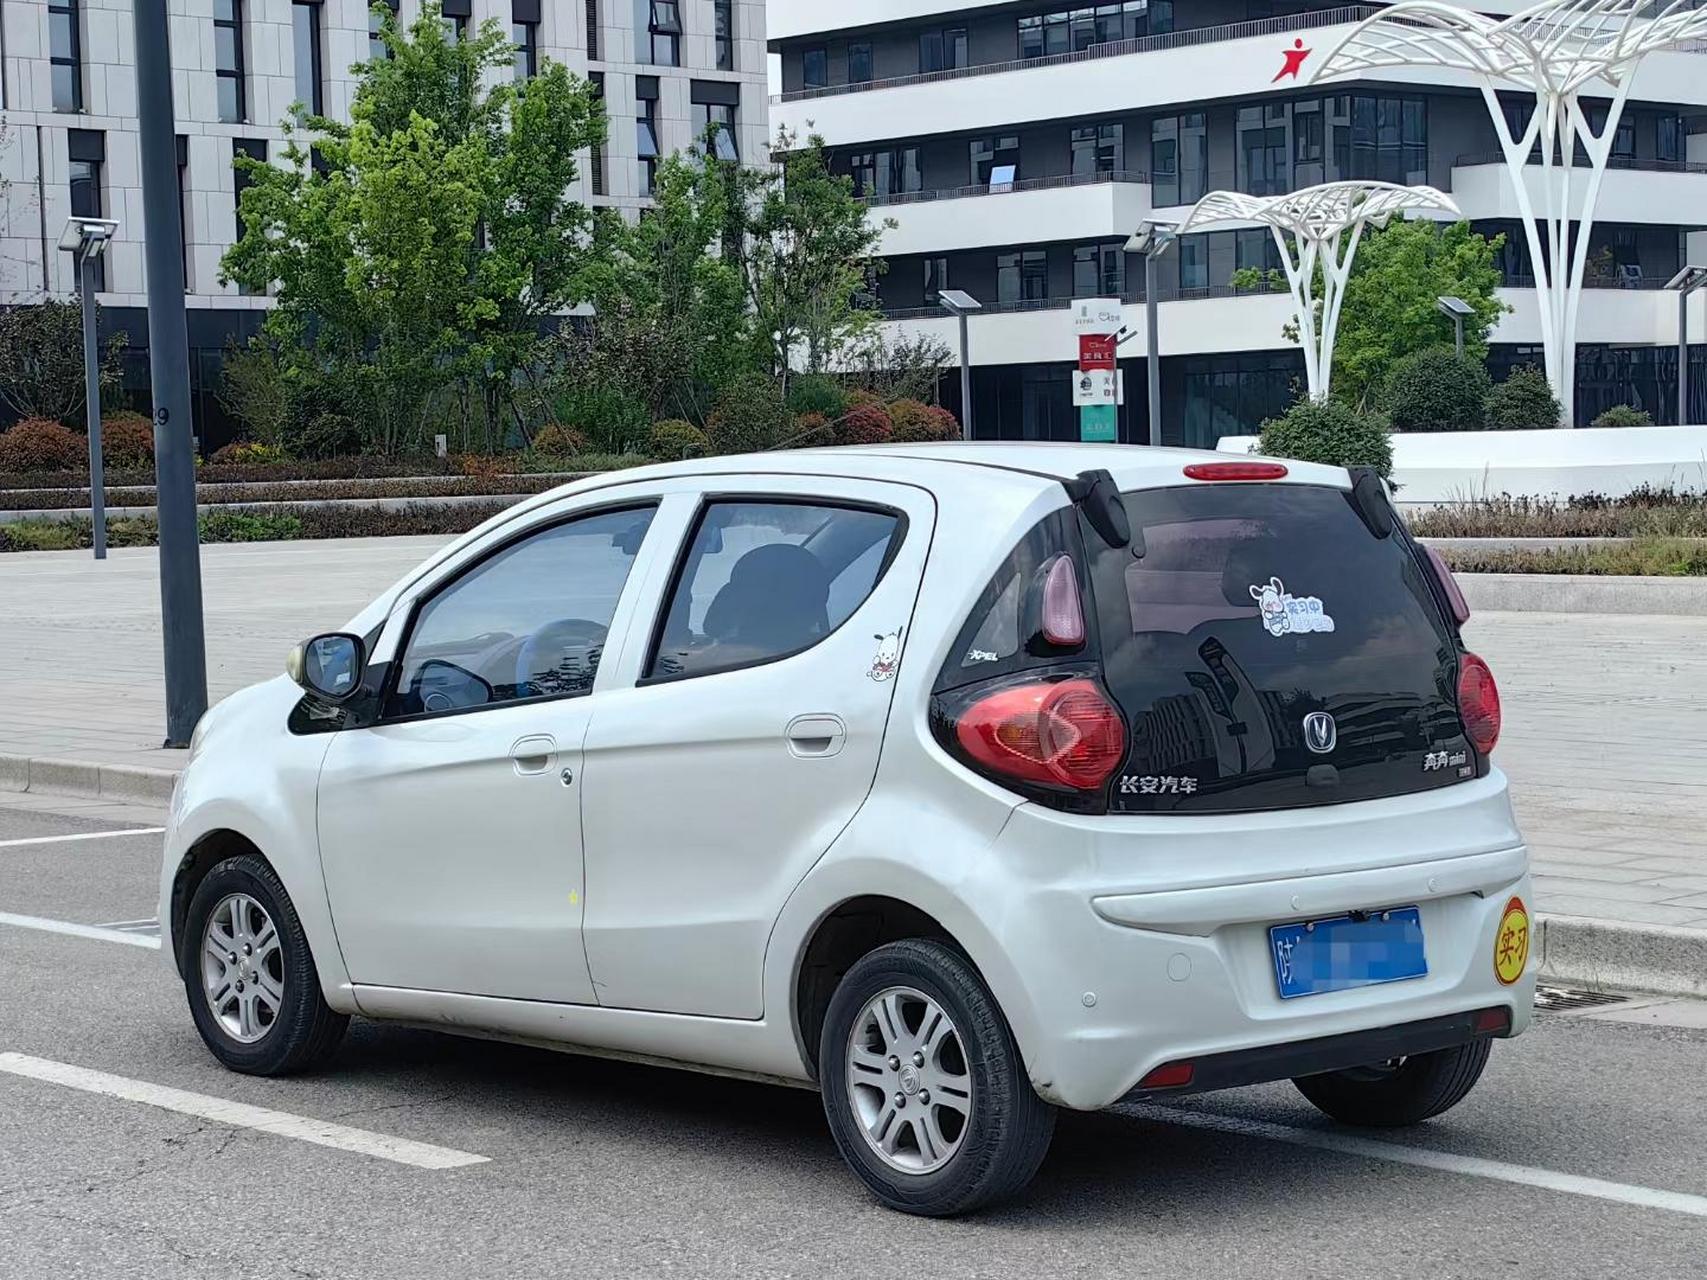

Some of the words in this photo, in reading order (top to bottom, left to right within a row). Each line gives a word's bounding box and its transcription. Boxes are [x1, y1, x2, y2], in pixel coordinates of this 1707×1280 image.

[1119, 775, 1198, 794] 长安汽车
[1499, 926, 1527, 966] 实习
